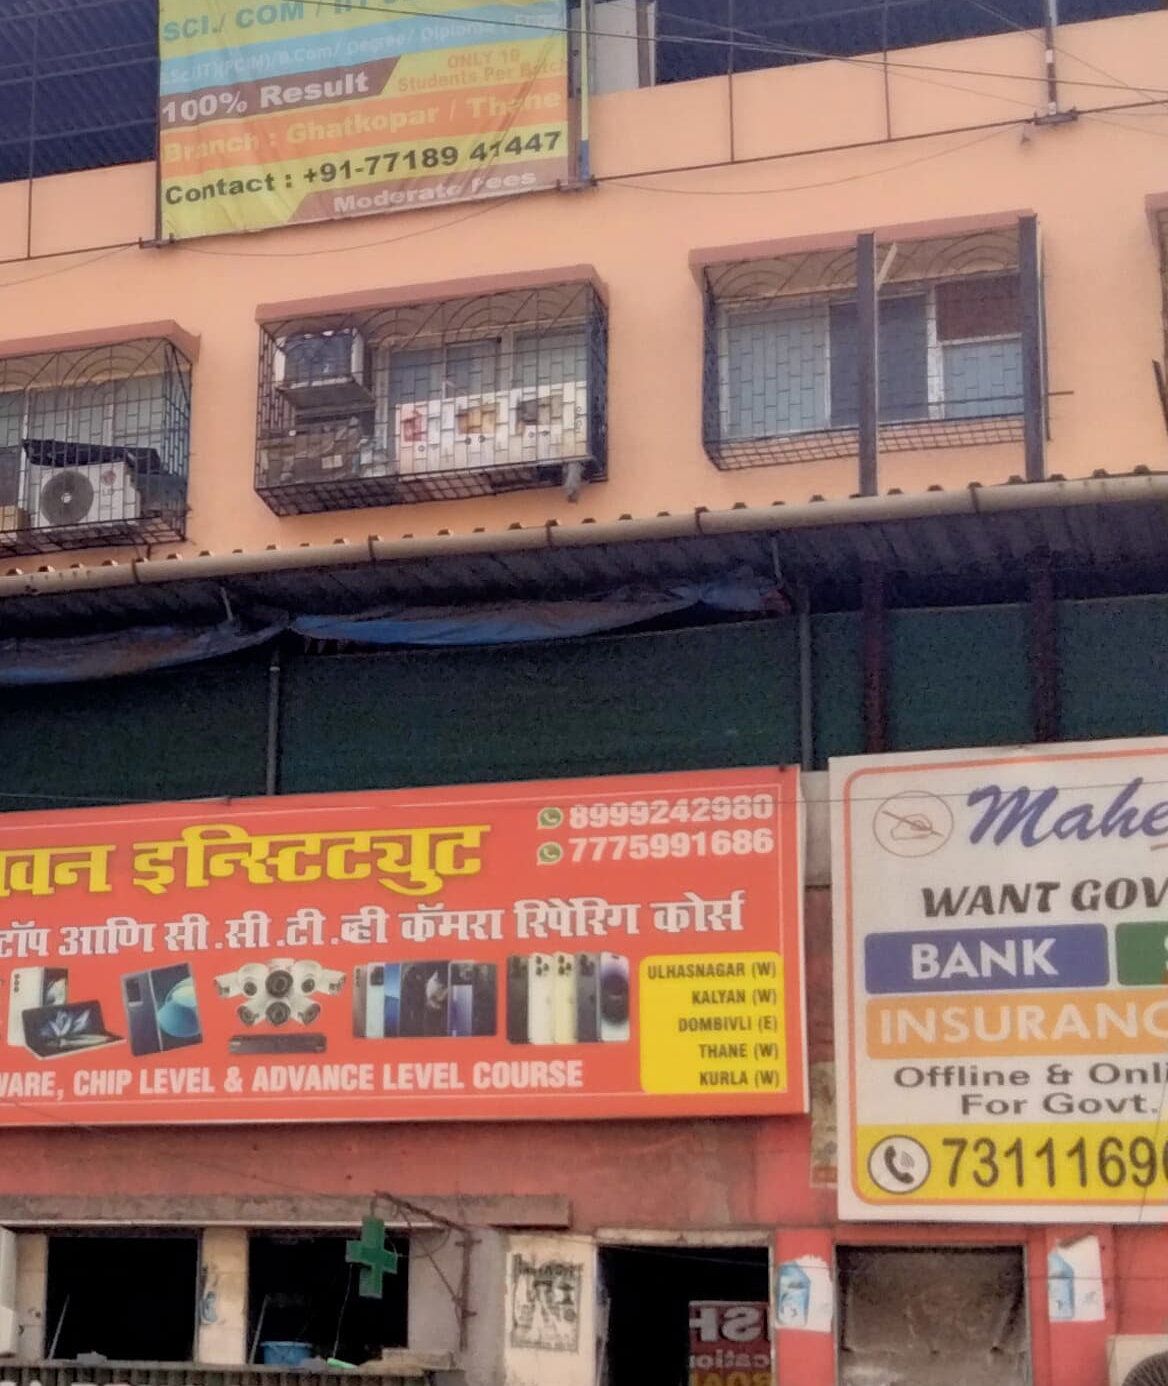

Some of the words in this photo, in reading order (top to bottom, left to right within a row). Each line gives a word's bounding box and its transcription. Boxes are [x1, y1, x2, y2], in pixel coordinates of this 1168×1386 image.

[235, 1, 305, 29] COM
[162, 91, 247, 123] 100%
[260, 71, 369, 109] Result
[163, 132, 258, 162] Branch
[287, 107, 440, 144] Ghatkopar
[466, 90, 562, 119] Thane
[165, 172, 275, 205] Contact
[304, 146, 458, 183] +91-77189
[470, 131, 562, 162] 41447
[334, 182, 463, 212] Moderate
[569, 794, 774, 830] 8999242980
[569, 828, 775, 863] 7775991686
[921, 881, 1062, 918] WANT
[59, 916, 157, 956] आणि
[650, 889, 747, 933] कोर्स
[647, 962, 746, 980] ULHASNAGAR
[752, 961, 777, 979] (W)
[910, 938, 1060, 981] BANK
[692, 989, 746, 1005] KALYAN
[753, 988, 777, 1006] (W)
[678, 1016, 752, 1032] DOMBIVLI
[758, 1015, 778, 1033] (E)
[699, 1043, 747, 1059] THANE
[754, 1042, 779, 1061] (W)
[73, 1069, 132, 1096] CHIP
[139, 1067, 215, 1094] LEVEL
[224, 1066, 243, 1092] &
[252, 1062, 374, 1093] ADVANCE
[383, 1061, 465, 1090] LEVEL
[473, 1059, 584, 1089] COURSE
[700, 1070, 749, 1086] KURLA
[754, 1070, 780, 1088] (W)
[894, 1066, 1031, 1088] Offline
[1046, 1063, 1073, 1086] &
[961, 1094, 1028, 1115] For
[1042, 1092, 1159, 1114] Govt.
[942, 1136, 1168, 1188] 7311169
